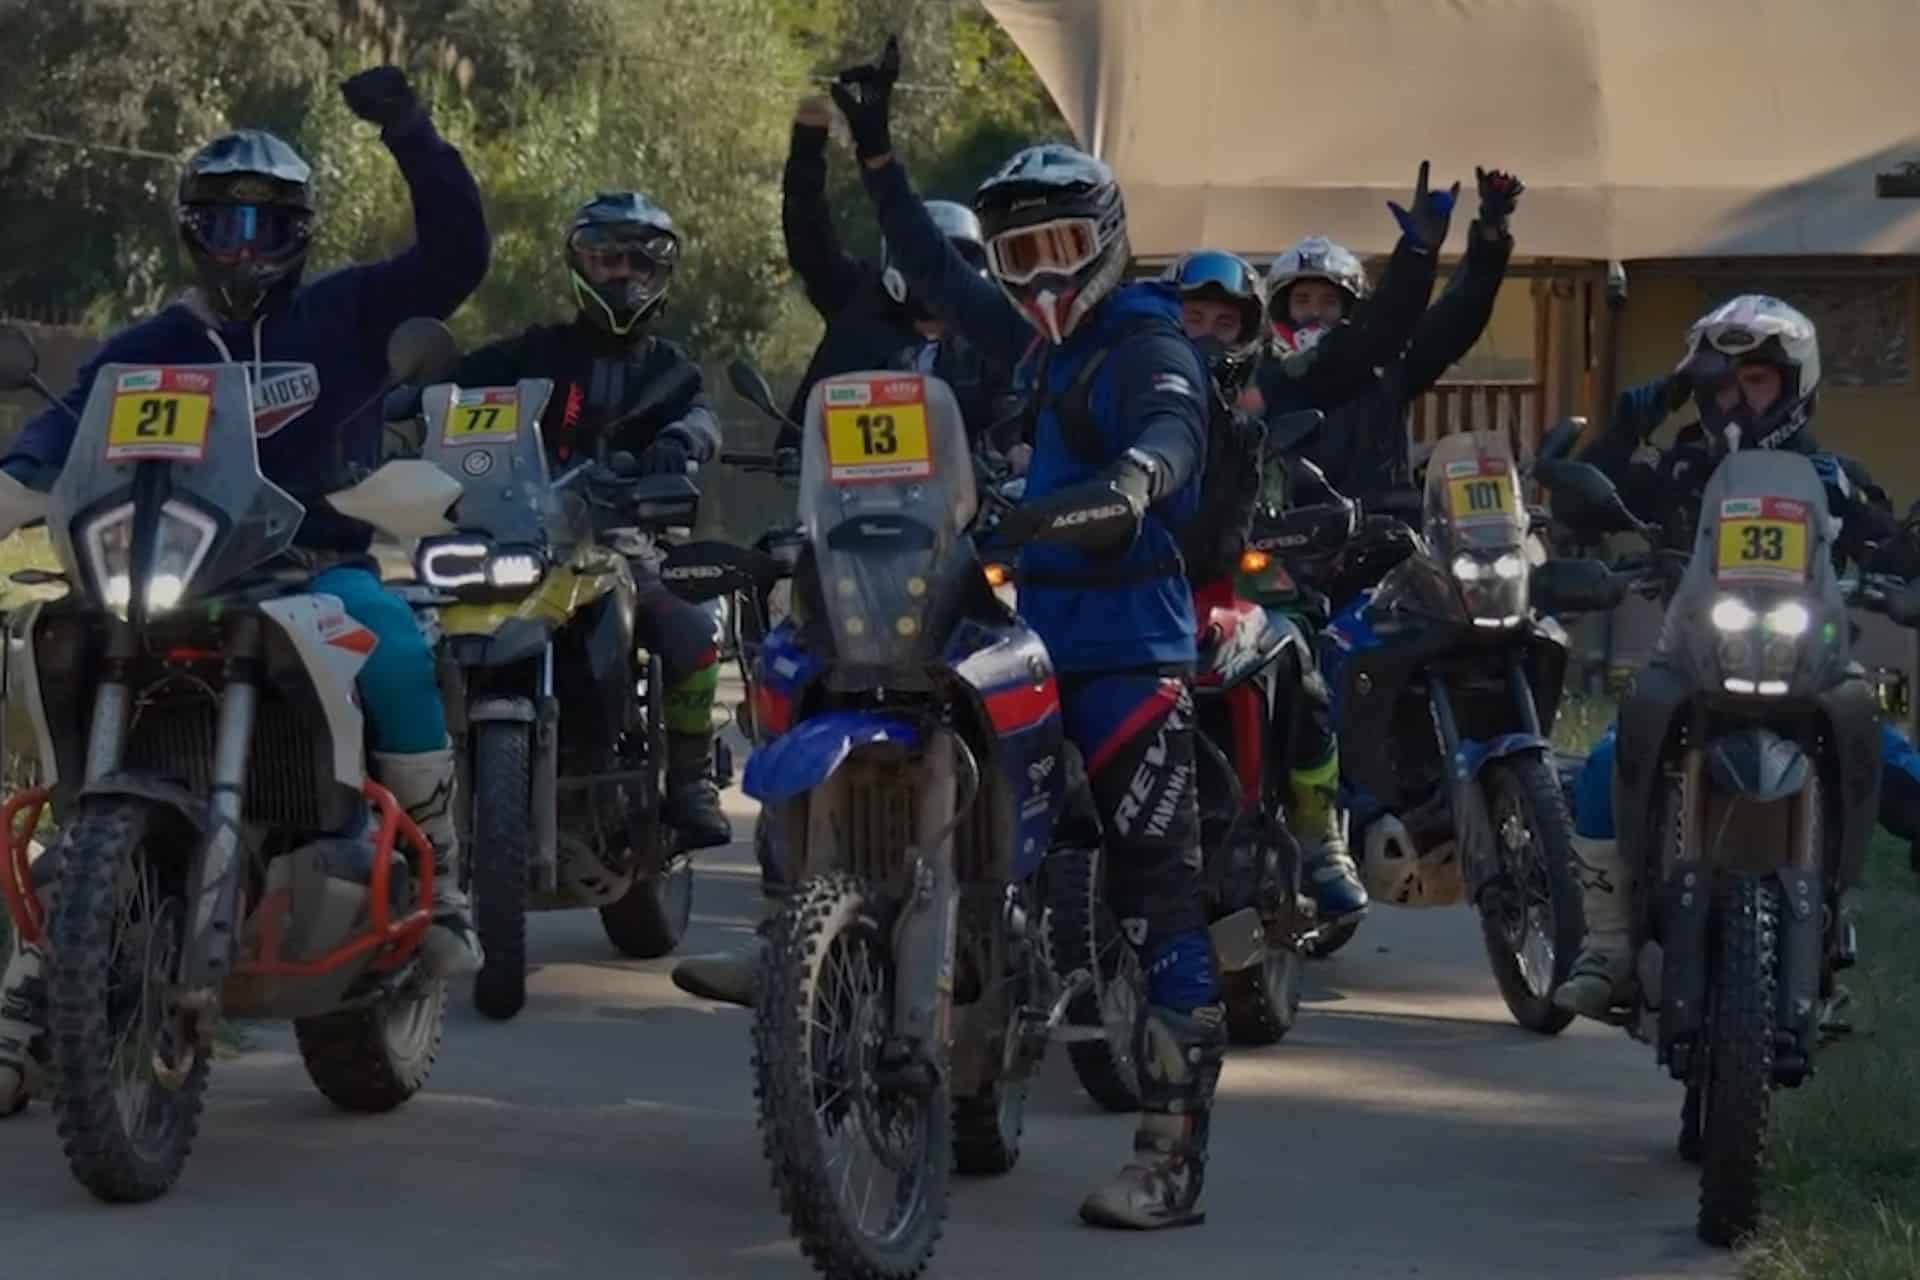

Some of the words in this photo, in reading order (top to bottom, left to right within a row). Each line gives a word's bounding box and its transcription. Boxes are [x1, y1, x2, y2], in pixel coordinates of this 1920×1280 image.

[136, 399, 178, 437] 21
[467, 407, 500, 431] 77
[856, 414, 897, 455] 13
[1463, 481, 1503, 510] 101
[1740, 525, 1783, 561] 33
